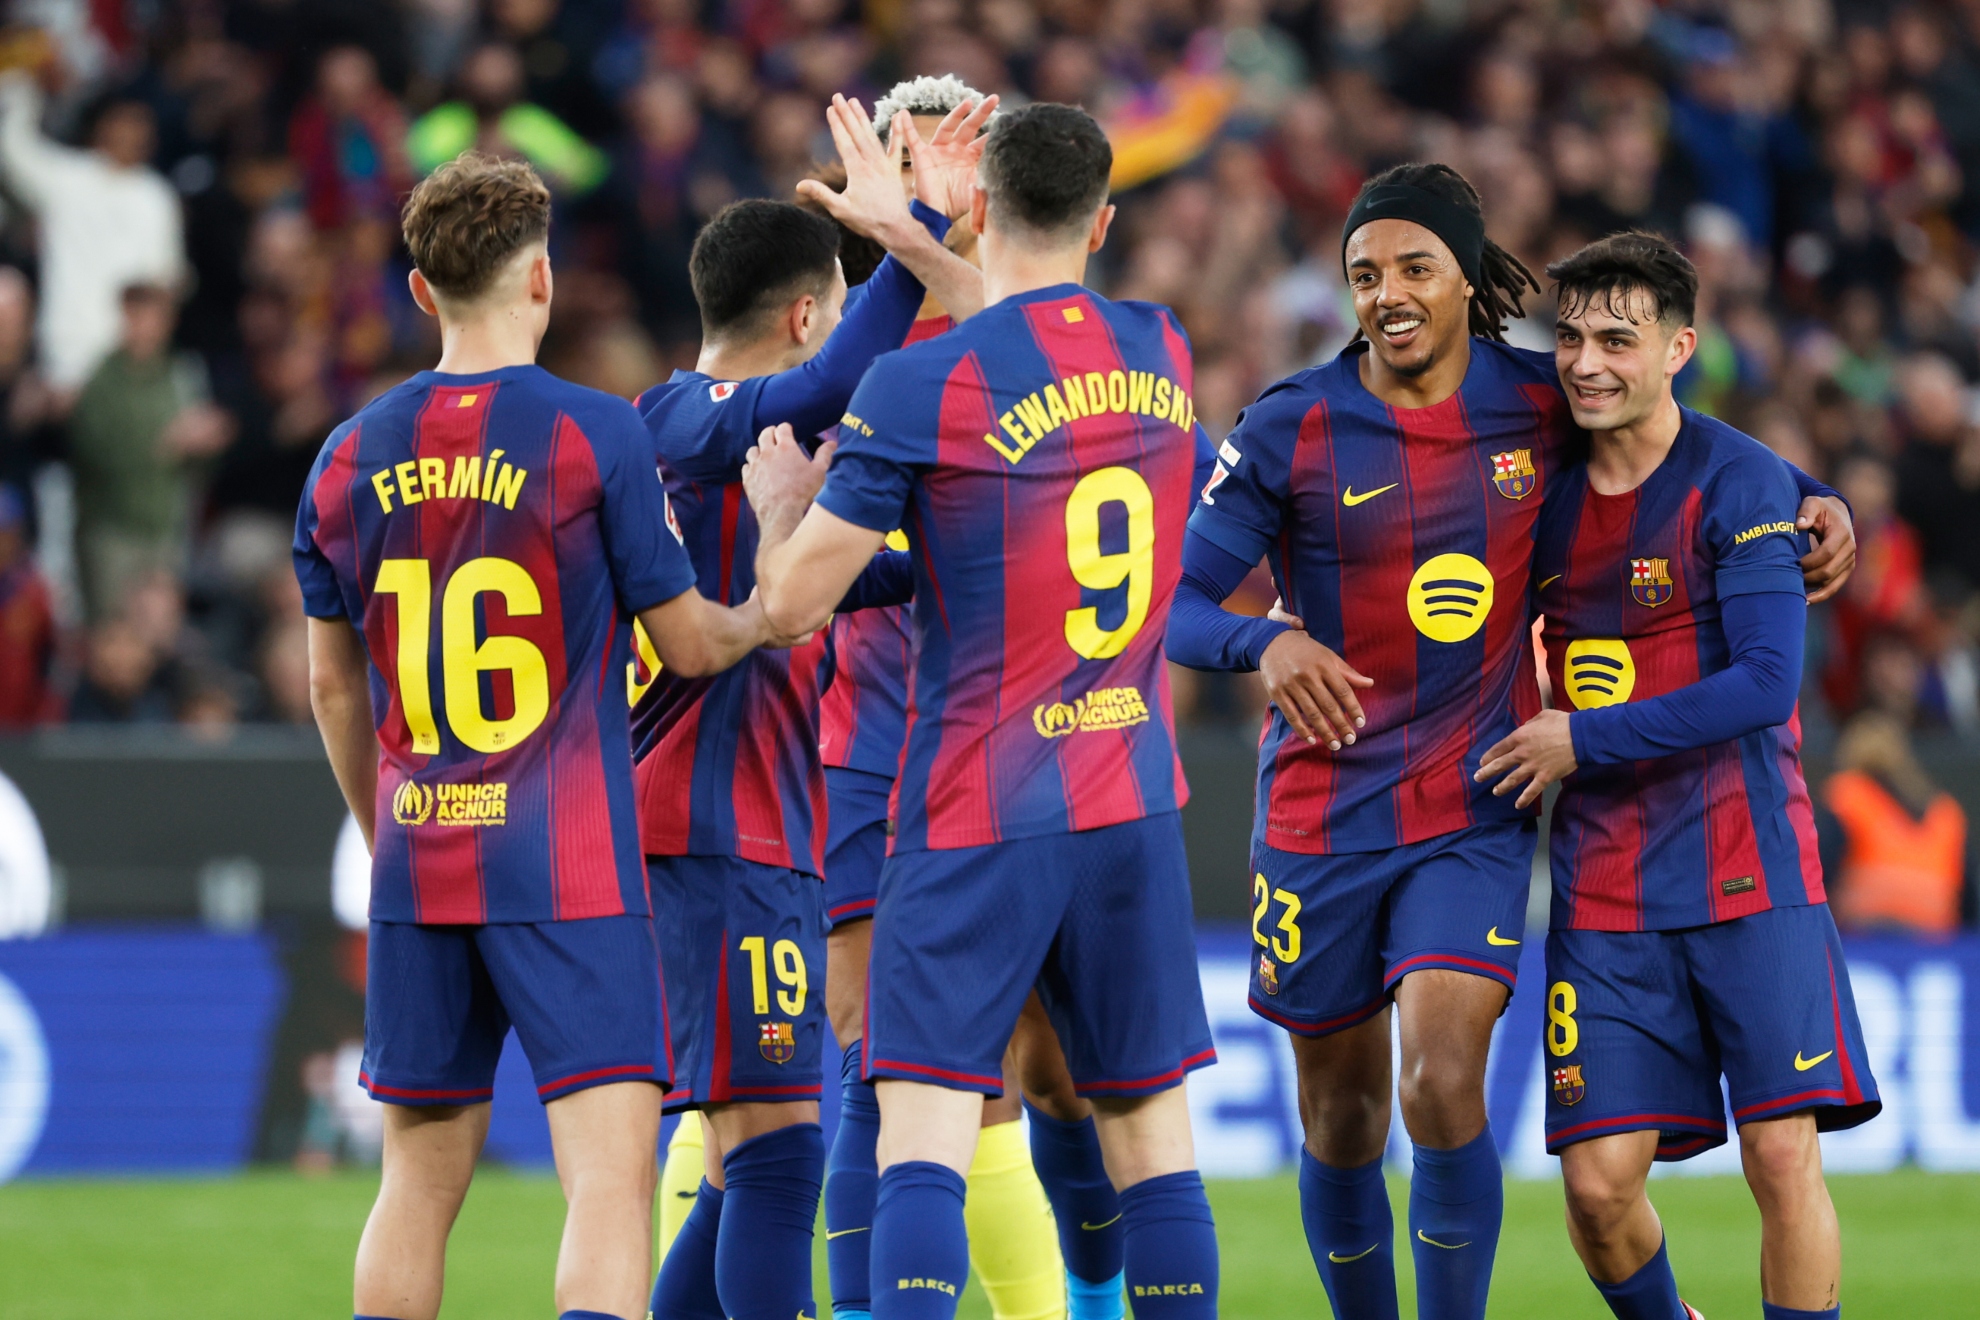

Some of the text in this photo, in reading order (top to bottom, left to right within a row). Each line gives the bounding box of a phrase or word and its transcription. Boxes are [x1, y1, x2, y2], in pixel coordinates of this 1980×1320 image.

[983, 370, 1194, 465] LEWANDOWSKI
[371, 448, 528, 515] FERMÍN
[1507, 469, 1524, 479] FCB
[1065, 466, 1155, 660] 9
[374, 557, 550, 755] 16
[436, 800, 507, 819] ACNUR
[437, 782, 508, 802] UNHCR
[1252, 872, 1302, 964] 23
[739, 936, 808, 1017] 19
[1548, 981, 1578, 1057] 8
[898, 1278, 956, 1297] BARÇA
[1134, 1282, 1204, 1297] BARÇA
